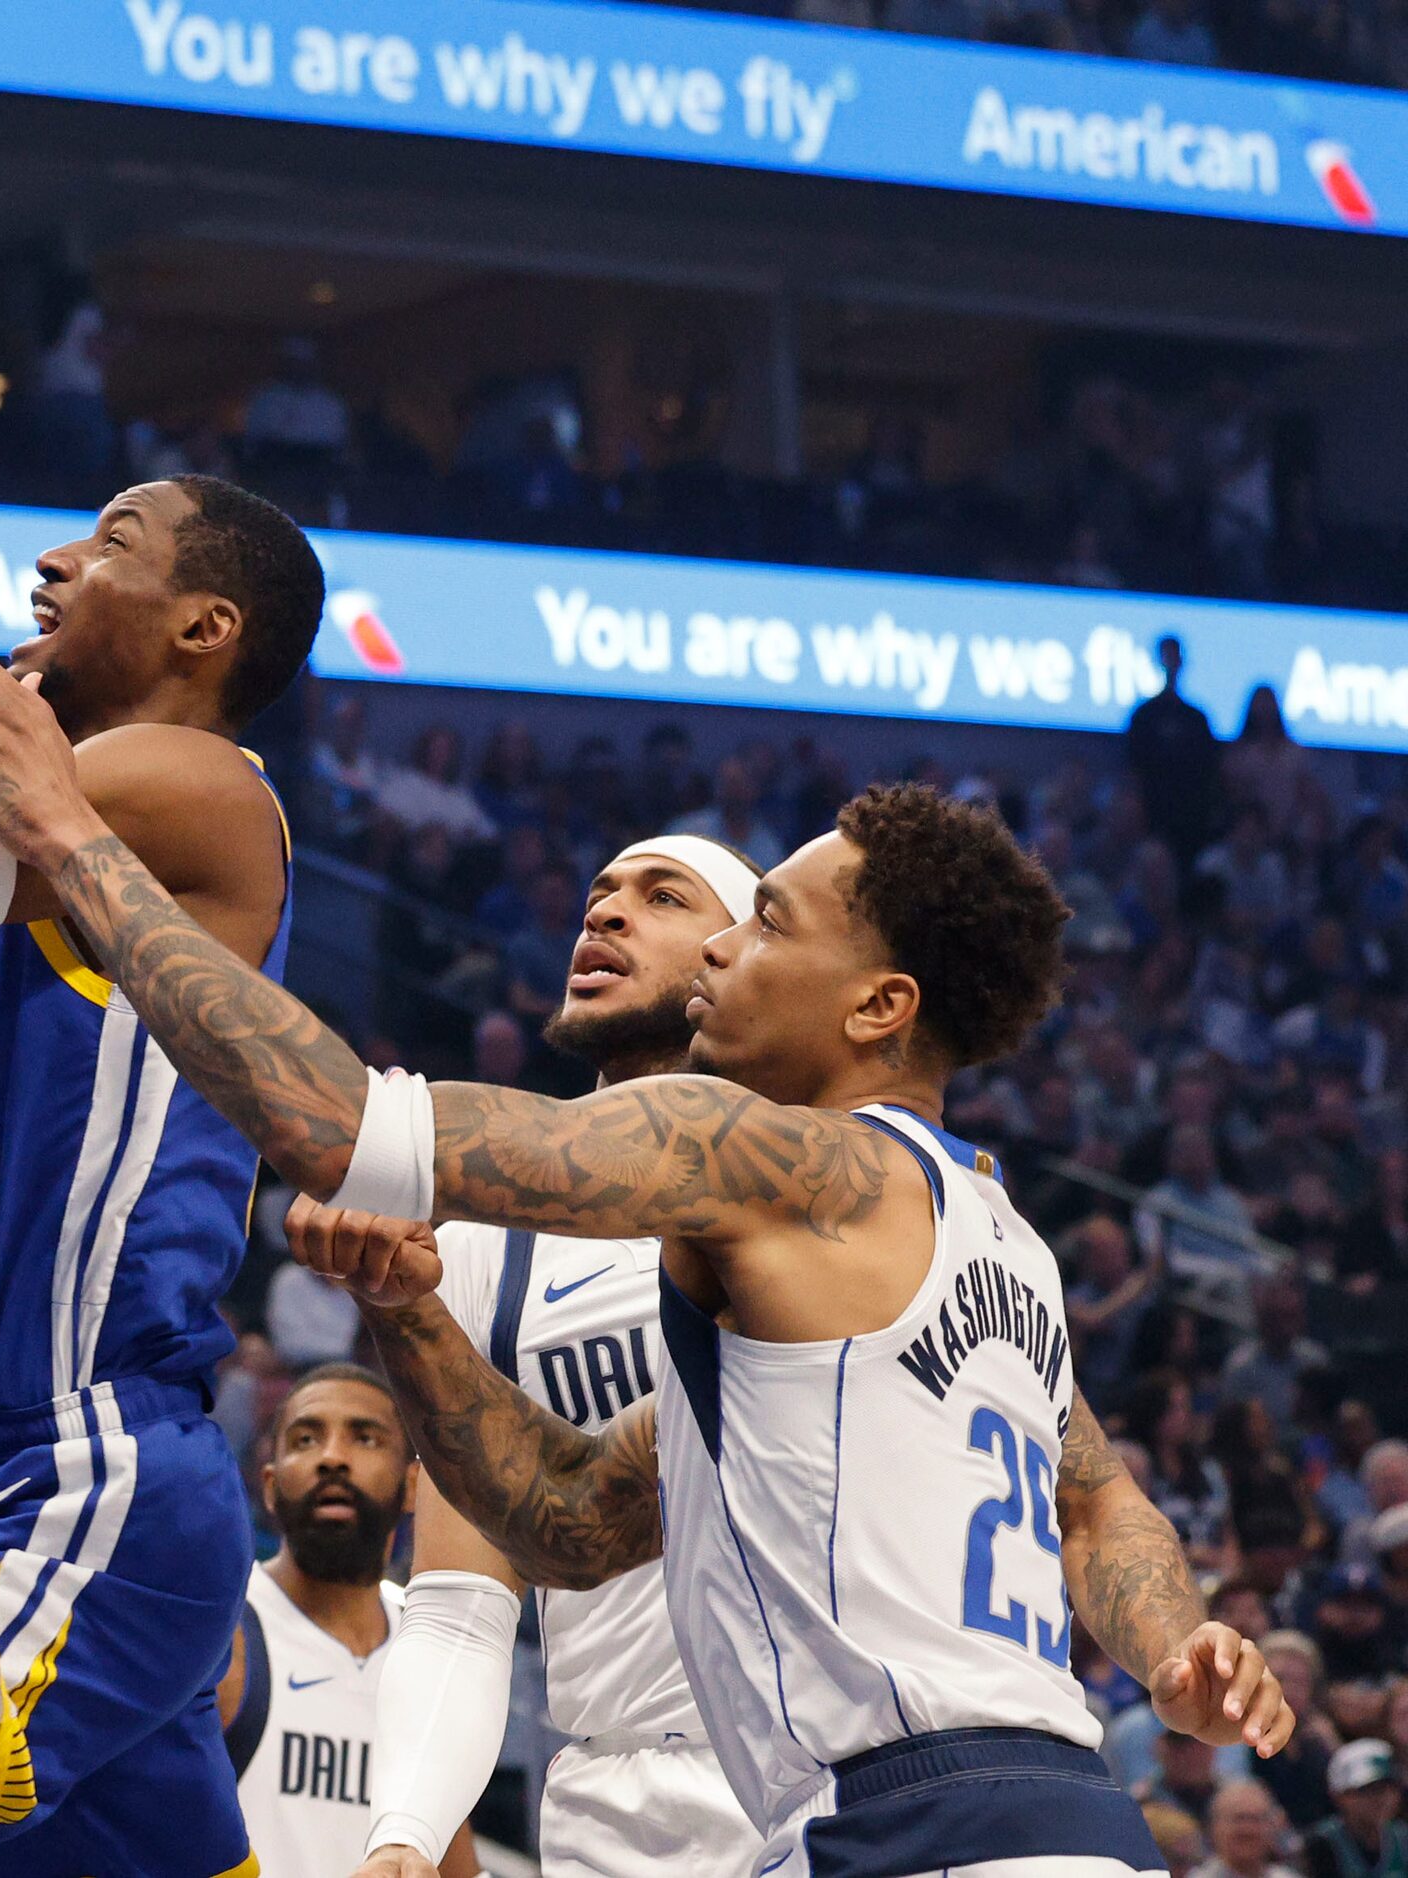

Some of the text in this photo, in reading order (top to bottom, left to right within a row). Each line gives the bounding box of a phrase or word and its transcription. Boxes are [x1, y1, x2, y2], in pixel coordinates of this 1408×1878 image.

[126, 0, 834, 163] You are why we fly
[963, 86, 1279, 195] American
[534, 583, 672, 673] You
[684, 612, 802, 683] are
[811, 610, 960, 711] why
[969, 633, 1074, 703] we
[896, 1256, 1068, 1403] WASHINGTON
[960, 1403, 1072, 1672] 25
